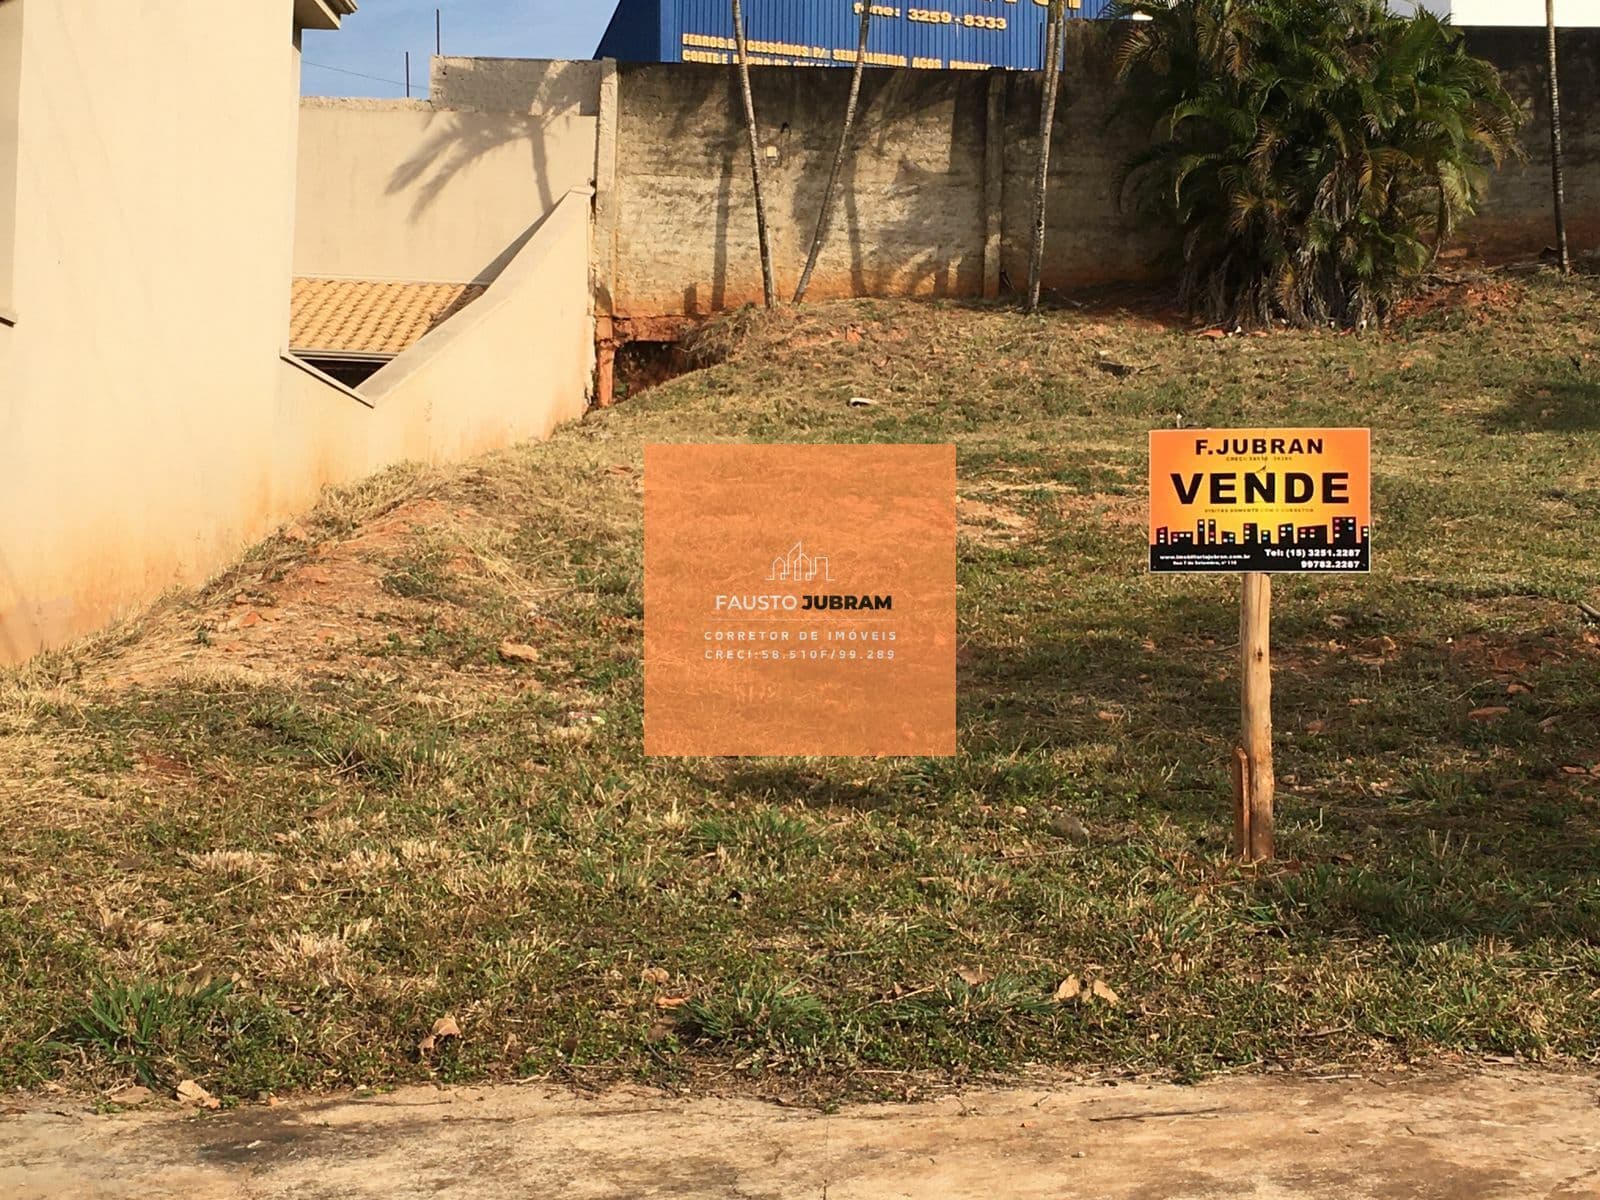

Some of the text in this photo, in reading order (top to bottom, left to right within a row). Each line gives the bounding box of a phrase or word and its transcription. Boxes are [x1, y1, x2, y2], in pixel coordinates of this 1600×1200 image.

[682, 33, 725, 49] FERROS
[740, 39, 809, 57] CESSÓRIOS
[1195, 438, 1323, 456] F.JUBRAN
[1170, 472, 1350, 504] VENDE
[1263, 549, 1361, 558] Tel: (15) 3251.2287
